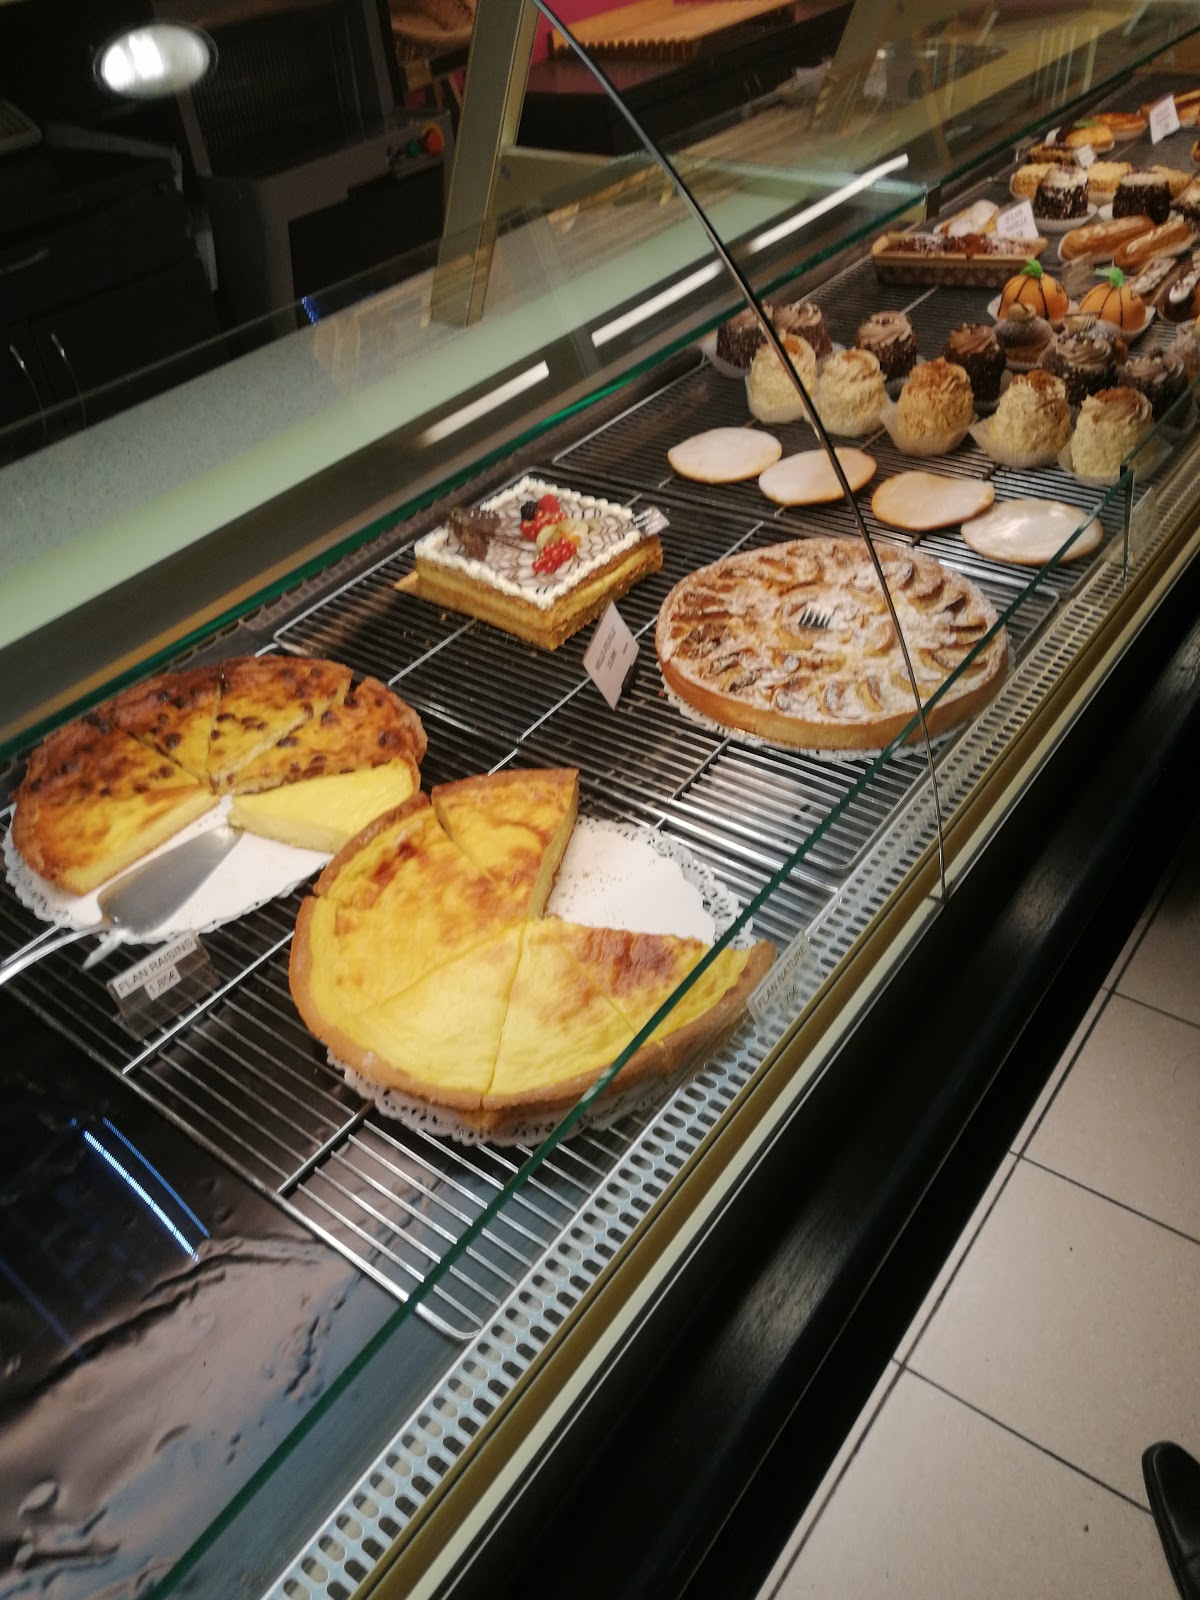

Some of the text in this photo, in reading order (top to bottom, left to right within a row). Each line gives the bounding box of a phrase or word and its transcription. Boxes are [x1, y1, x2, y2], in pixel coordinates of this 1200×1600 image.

[118, 937, 194, 994] FLAN RAISINS
[757, 942, 806, 1008] FLAN NATURE
